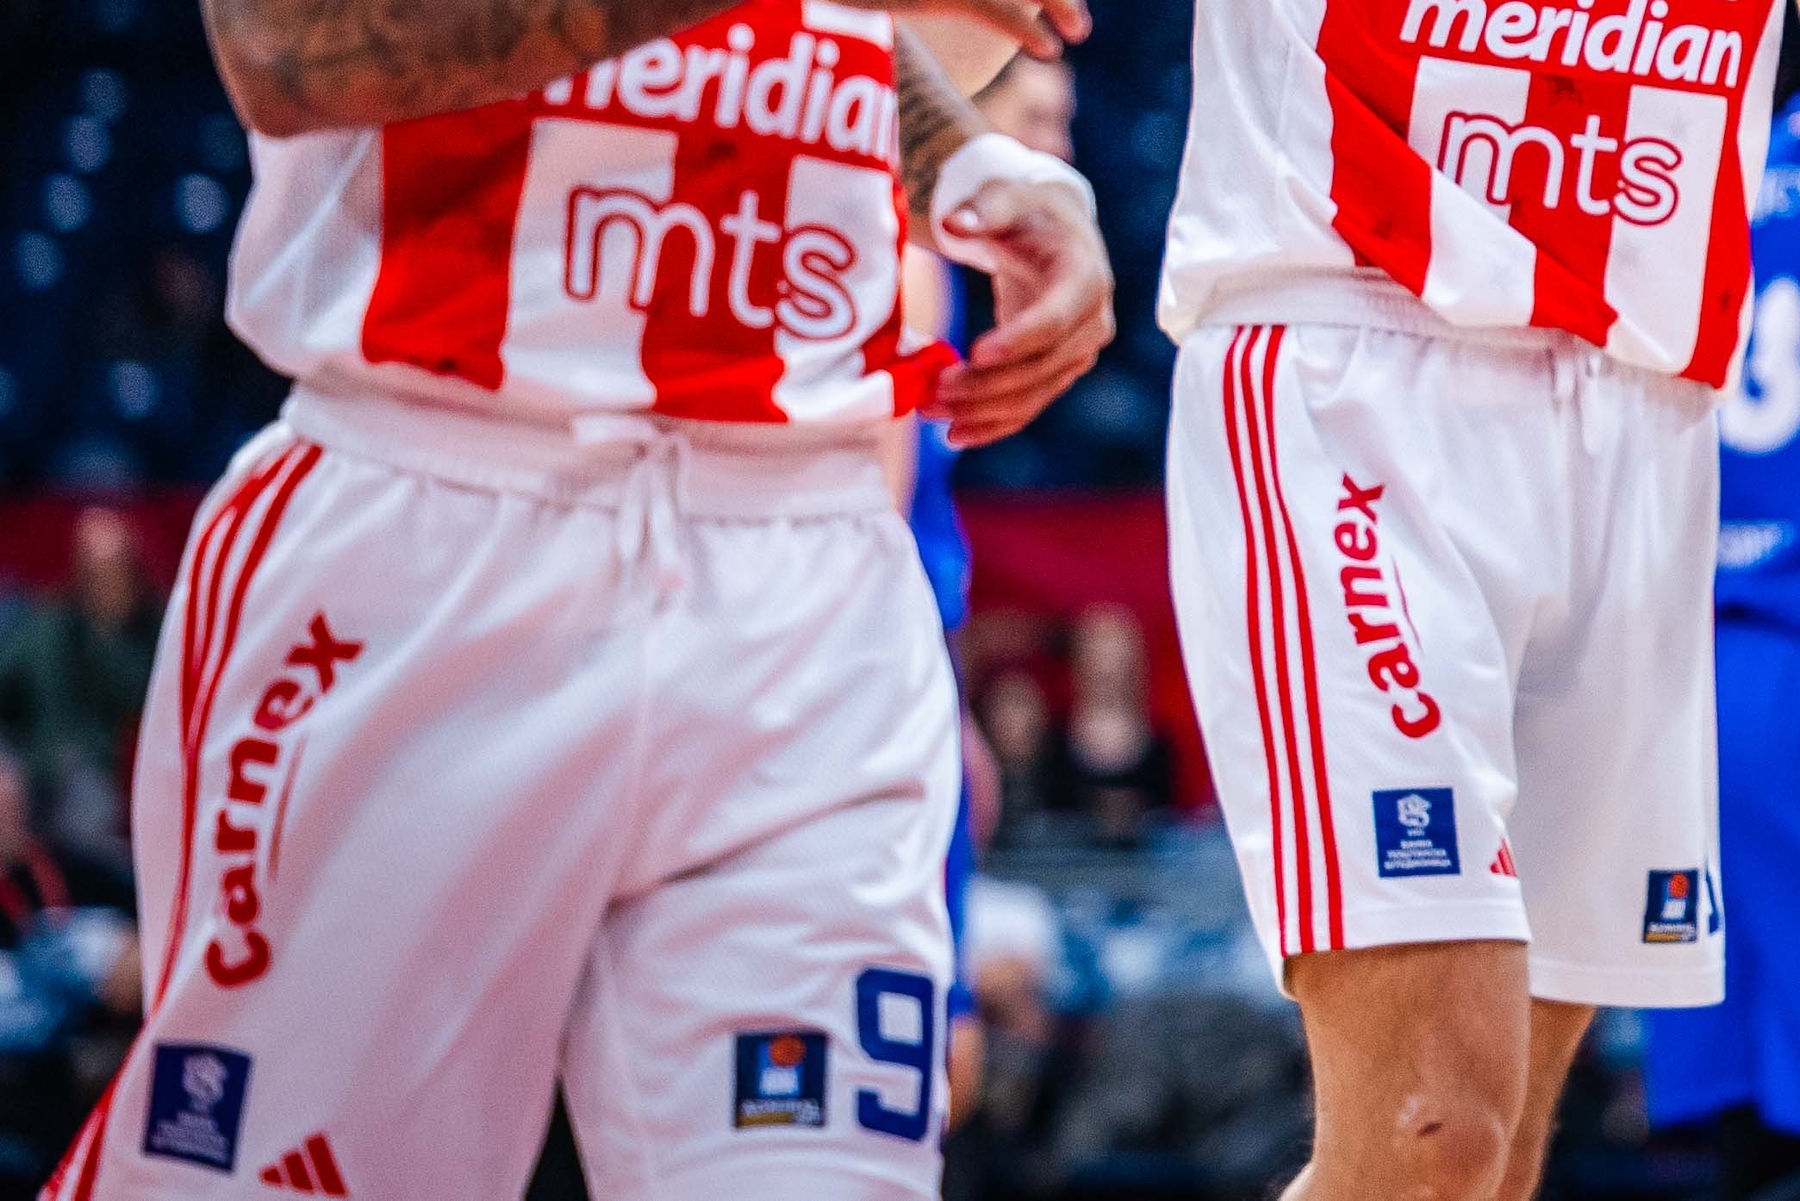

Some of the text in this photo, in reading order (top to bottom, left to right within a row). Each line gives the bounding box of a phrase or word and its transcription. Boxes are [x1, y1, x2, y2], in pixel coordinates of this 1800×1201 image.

[1437, 111, 1683, 227] mts
[565, 186, 858, 341] mts
[1334, 473, 1441, 738] carnex
[206, 611, 365, 988] carnex
[856, 967, 934, 1142] 9
